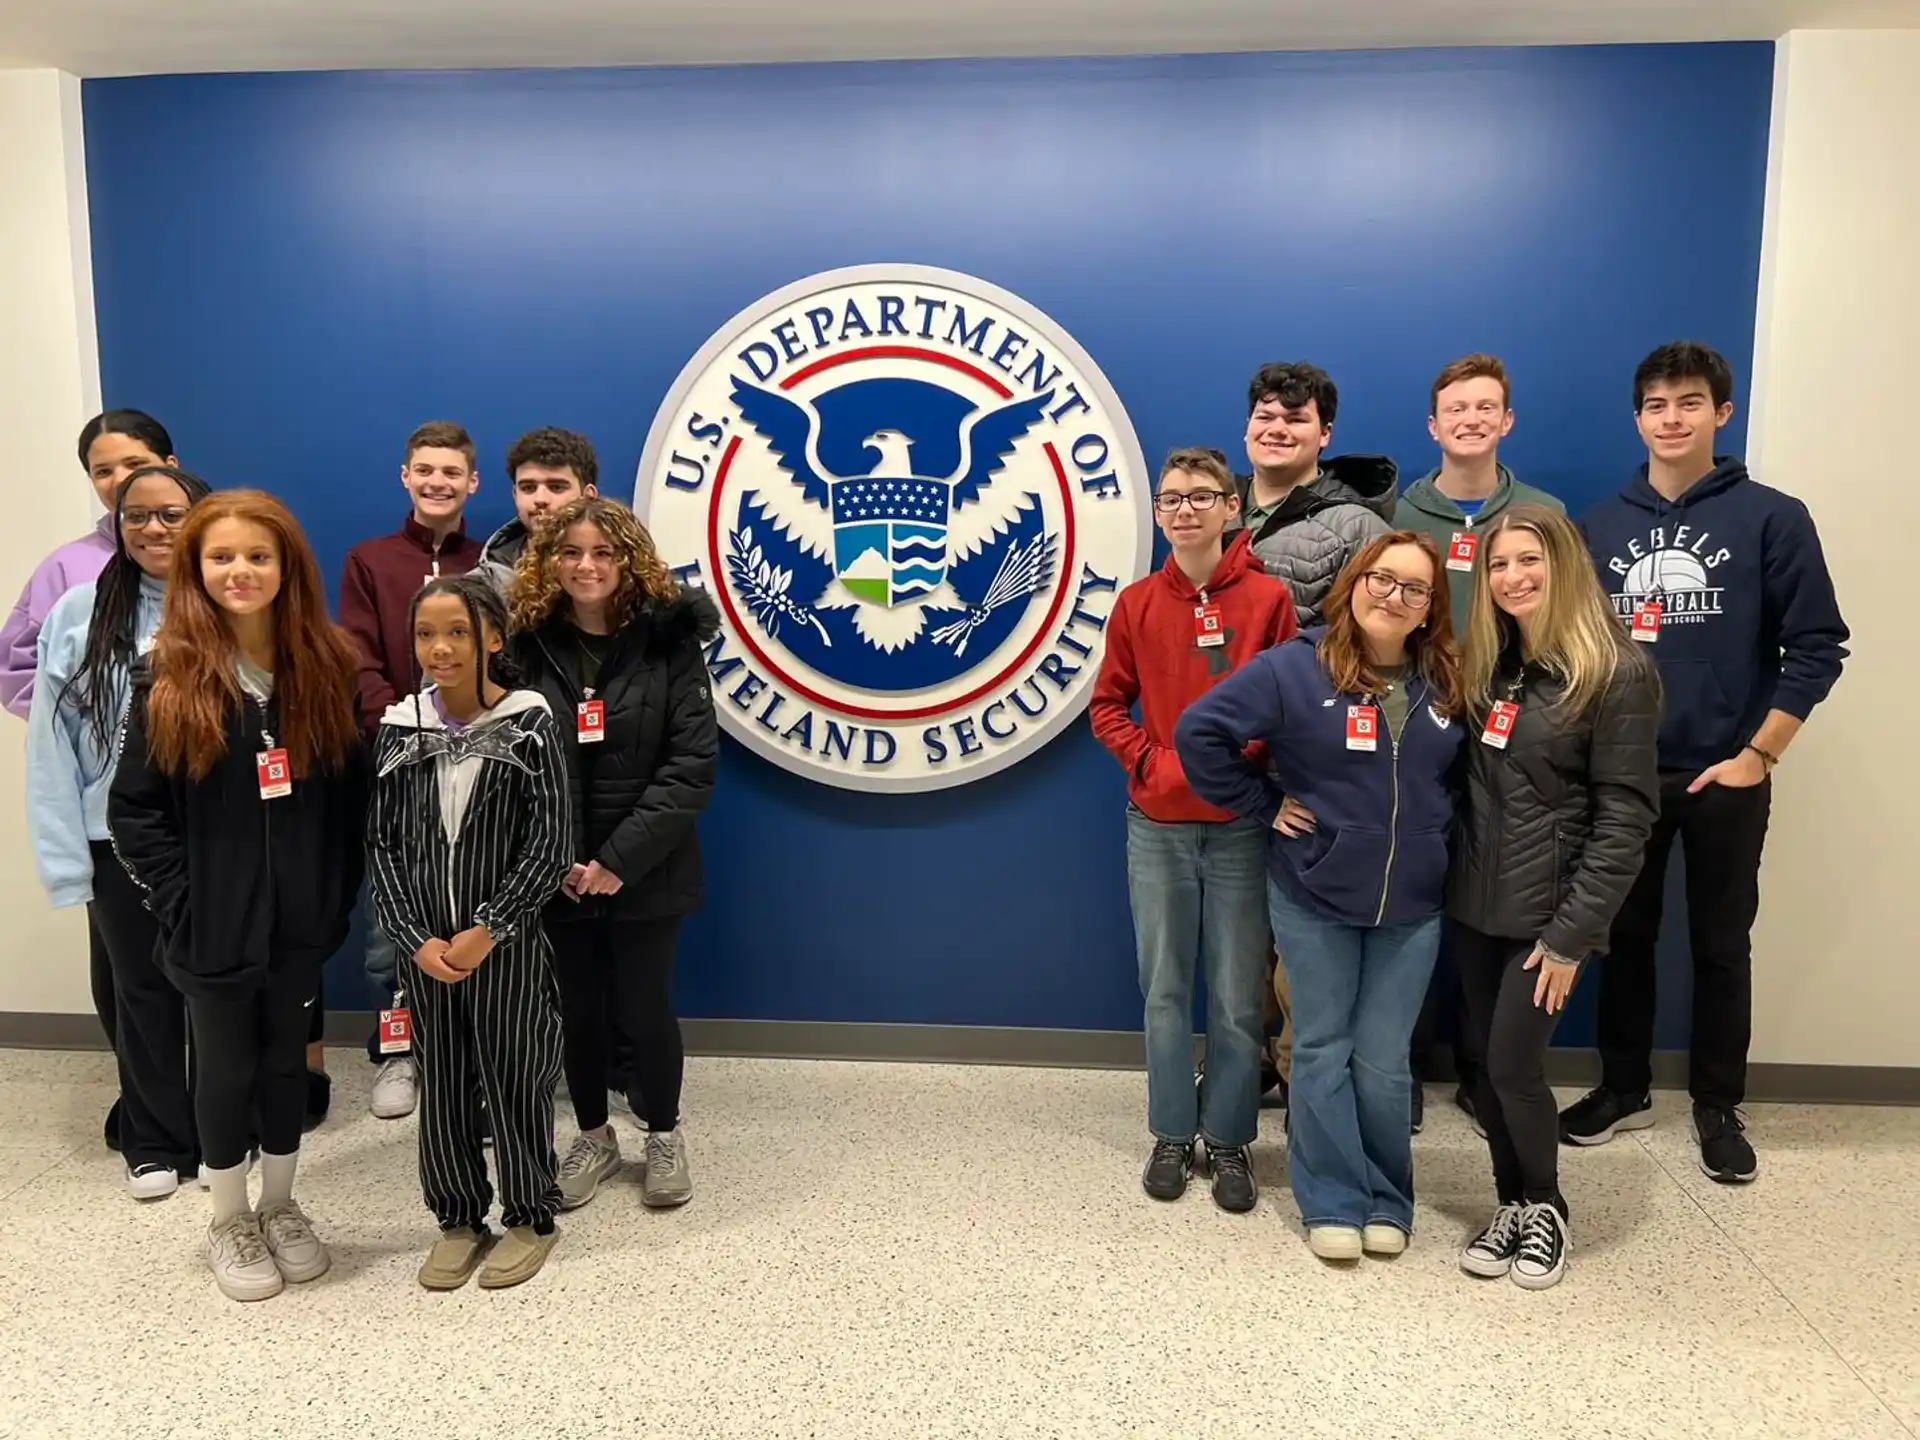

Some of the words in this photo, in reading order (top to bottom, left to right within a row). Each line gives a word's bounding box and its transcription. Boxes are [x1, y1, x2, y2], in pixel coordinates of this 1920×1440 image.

[666, 412, 729, 491] U.S.
[738, 296, 1091, 424] DEPARTMENT
[1071, 433, 1121, 499] OF
[1609, 525, 1731, 576] REBELS
[1611, 592, 1722, 613] VOLYBALL
[1674, 615, 1705, 625] SCHOOL
[669, 558, 896, 764] MELAND
[922, 562, 1118, 763] SECURITY
